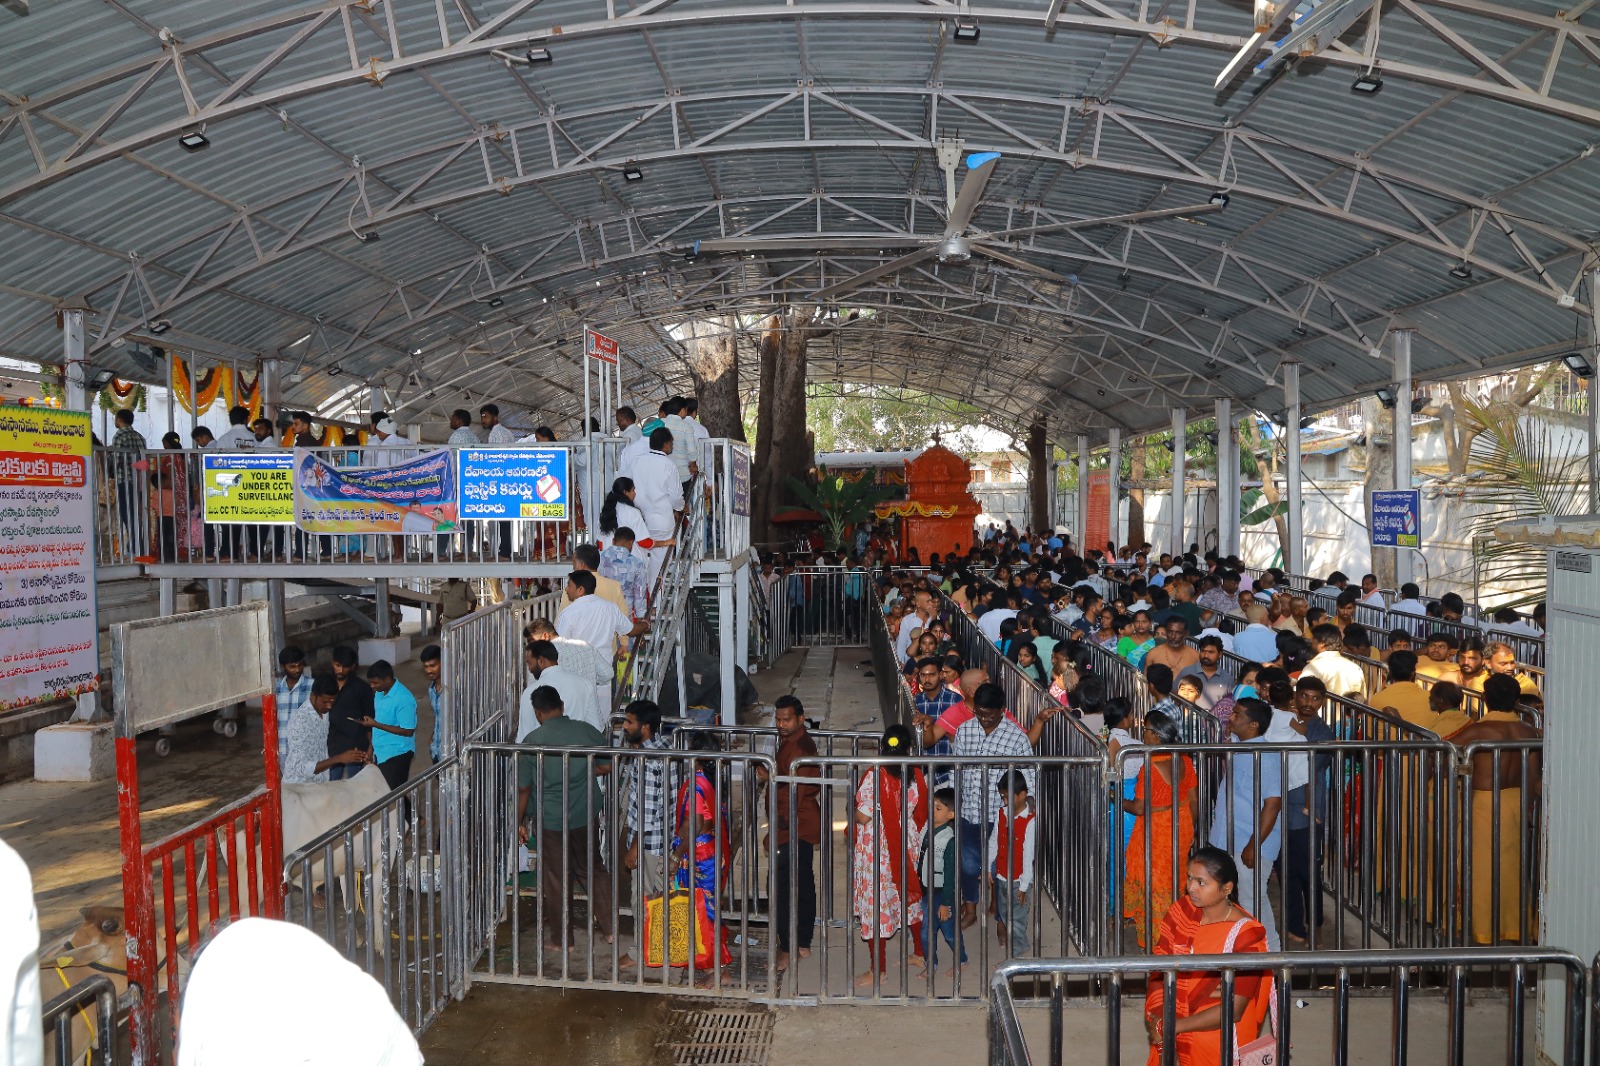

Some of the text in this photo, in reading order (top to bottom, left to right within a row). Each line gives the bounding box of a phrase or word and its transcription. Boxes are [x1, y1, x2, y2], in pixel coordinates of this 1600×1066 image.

[0, 417, 85, 440] వస్థానము, వేములవాడ
[52, 461, 82, 485] విజ్ఞప్తి
[251, 472, 287, 480] YOU ARE
[464, 465, 548, 477] దేవాలయ ఆవరణలో
[243, 482, 270, 491] UNDER
[464, 481, 533, 500] ప్లాస్టిక్ కవర్లు
[238, 492, 294, 501] SURVEILLANC
[219, 506, 229, 514] CC
[231, 506, 239, 514] TV
[464, 503, 506, 514] వాడరాదు
